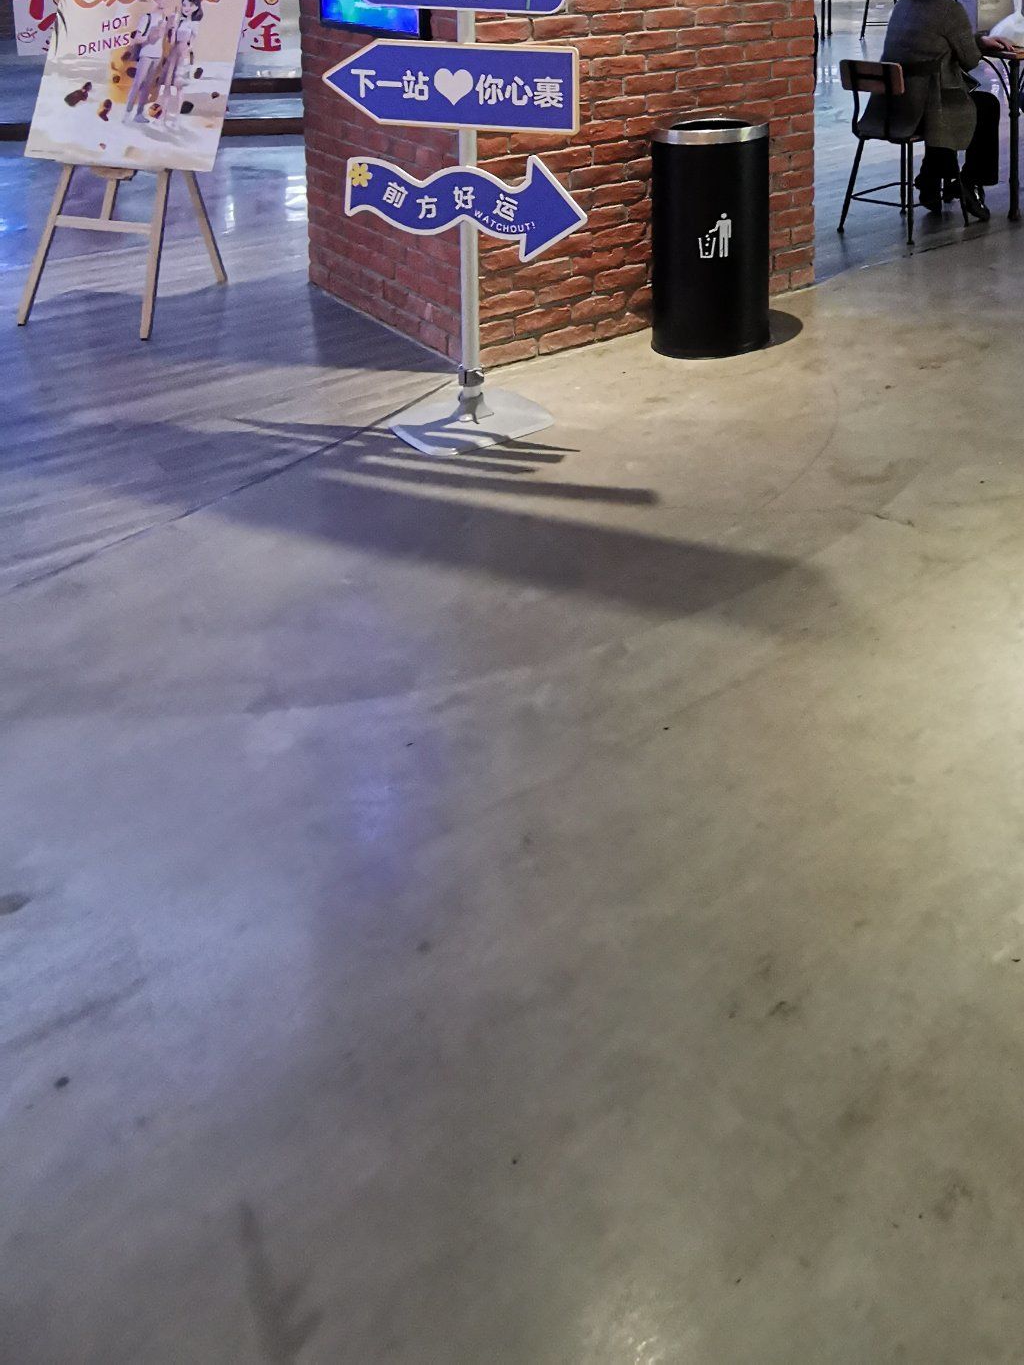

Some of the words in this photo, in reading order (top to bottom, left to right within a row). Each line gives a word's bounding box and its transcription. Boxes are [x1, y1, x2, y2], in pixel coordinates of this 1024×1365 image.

[101, 15, 130, 33] HOT
[77, 33, 130, 56] DRINKS
[350, 68, 430, 102] 下一站
[382, 180, 520, 222] 前方好运
